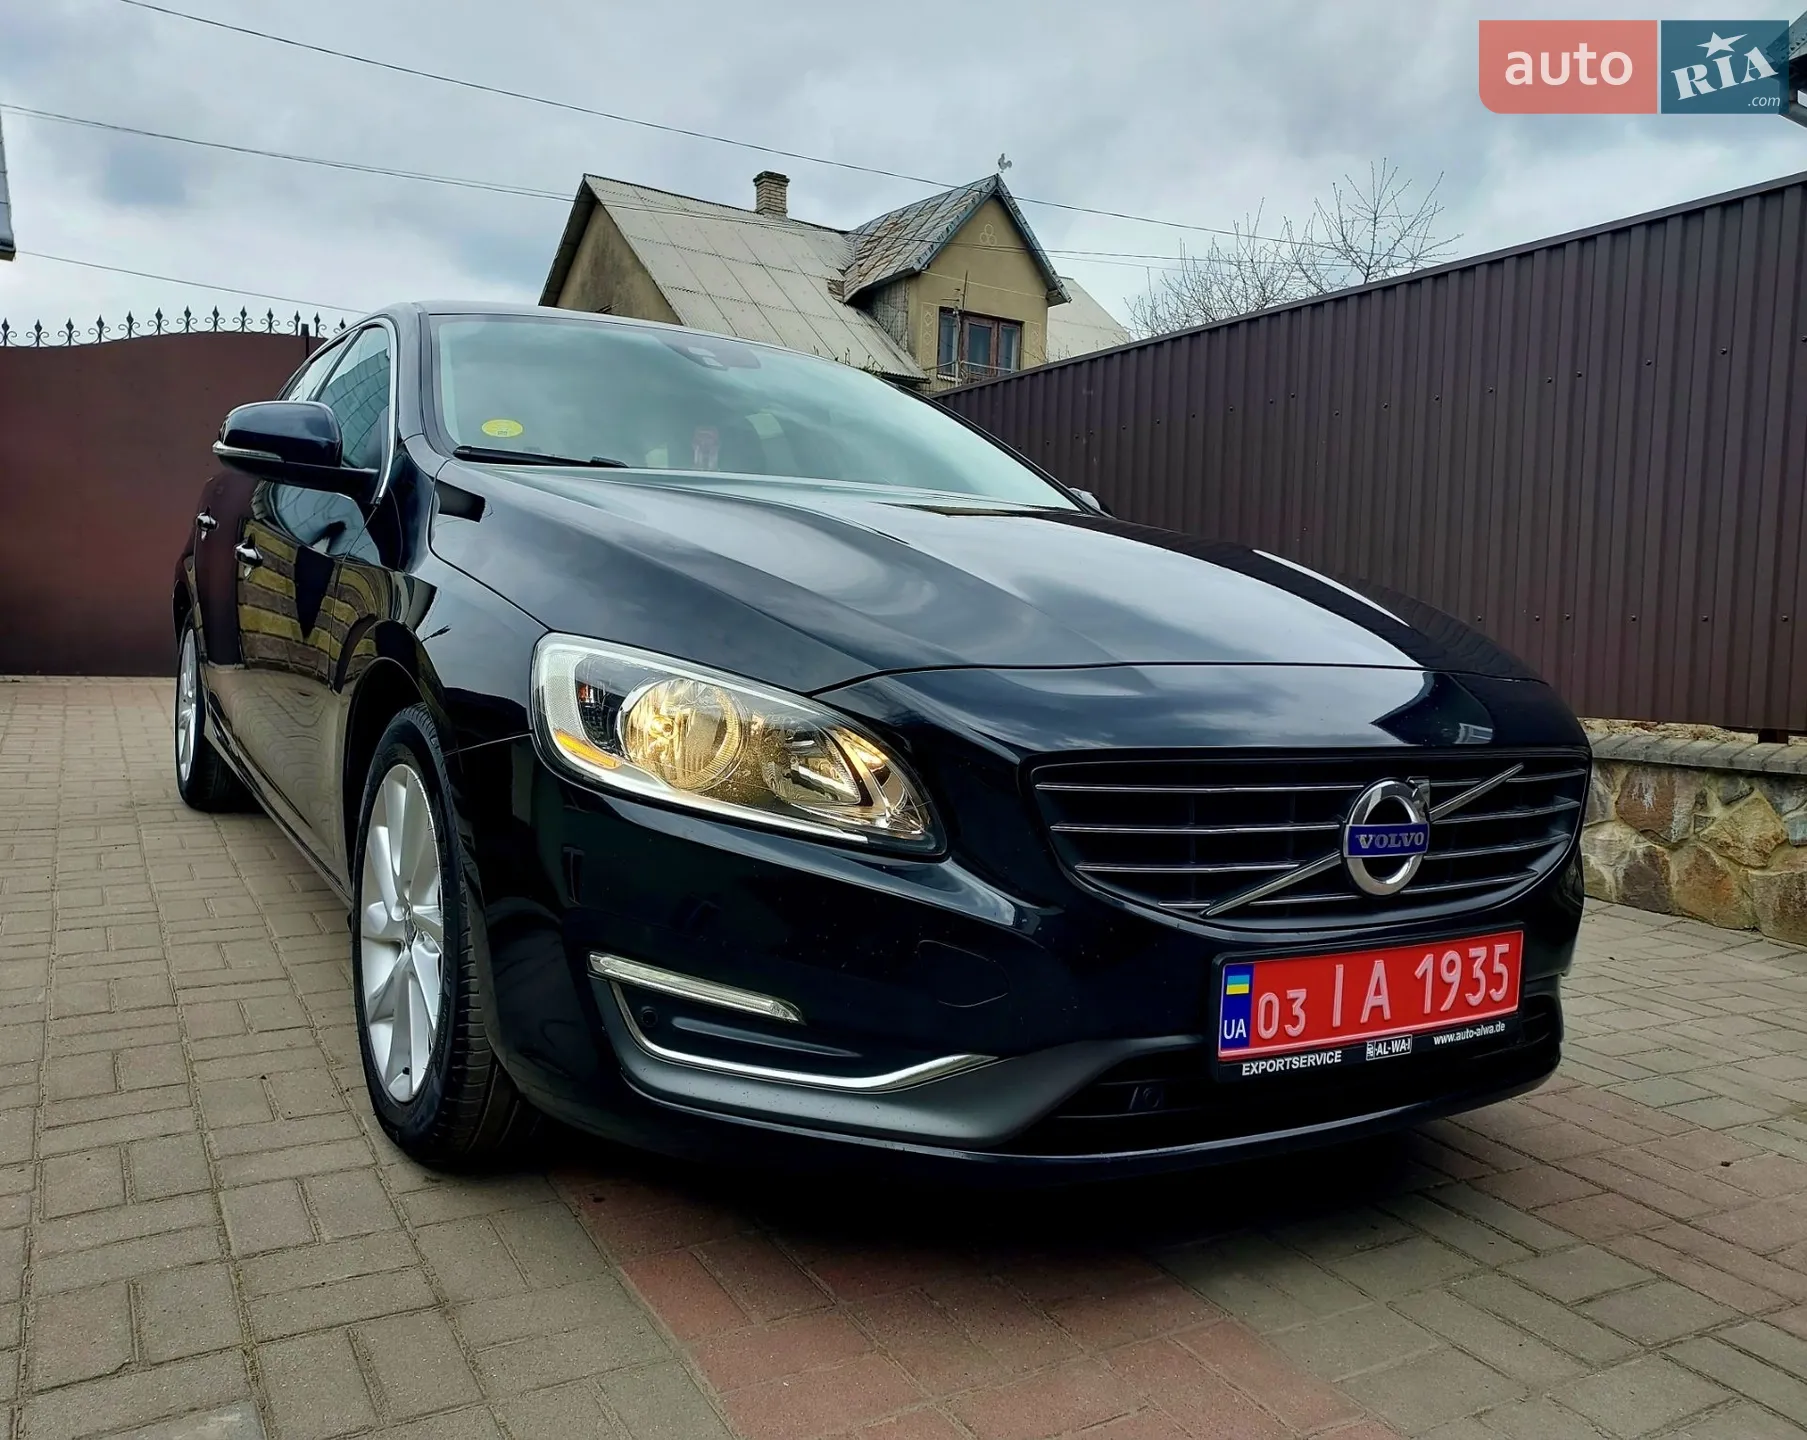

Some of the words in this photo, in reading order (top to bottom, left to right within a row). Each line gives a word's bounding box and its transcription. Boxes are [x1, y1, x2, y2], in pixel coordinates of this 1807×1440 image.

[1356, 831, 1425, 849] VOLVO
[1257, 988, 1308, 1040] 03
[1414, 943, 1510, 1015] 1935
[1223, 1018, 1247, 1040] UA
[1241, 1050, 1342, 1076] EXPORTSERVICE
